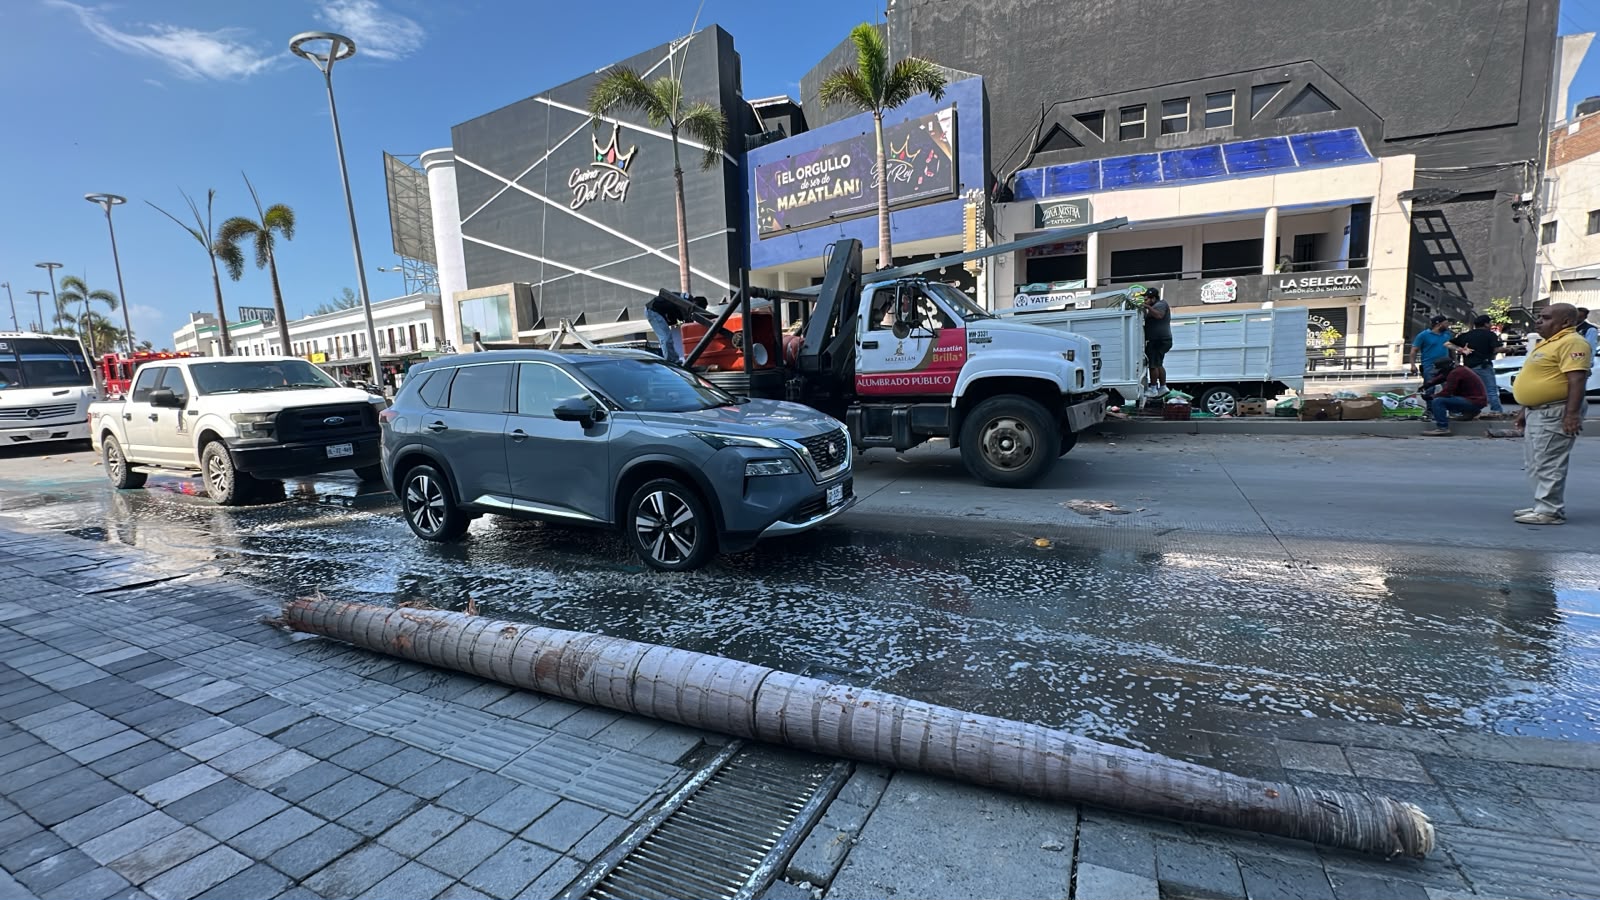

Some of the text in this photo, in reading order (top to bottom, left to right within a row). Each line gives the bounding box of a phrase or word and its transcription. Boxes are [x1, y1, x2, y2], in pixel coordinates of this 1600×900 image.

[795, 154, 851, 180] ORGULLO
[568, 168, 599, 188] Casino
[570, 170, 630, 209] Del Rey
[777, 178, 860, 212] MAZATLÁN!
[1280, 275, 1362, 288] LA SELECTA
[1326, 284, 1356, 292] SINALOA
[1030, 294, 1073, 304] YATEANDO
[933, 345, 963, 353] Mazatlán
[857, 375, 951, 387] ALUMBRADO PÚBLICO
